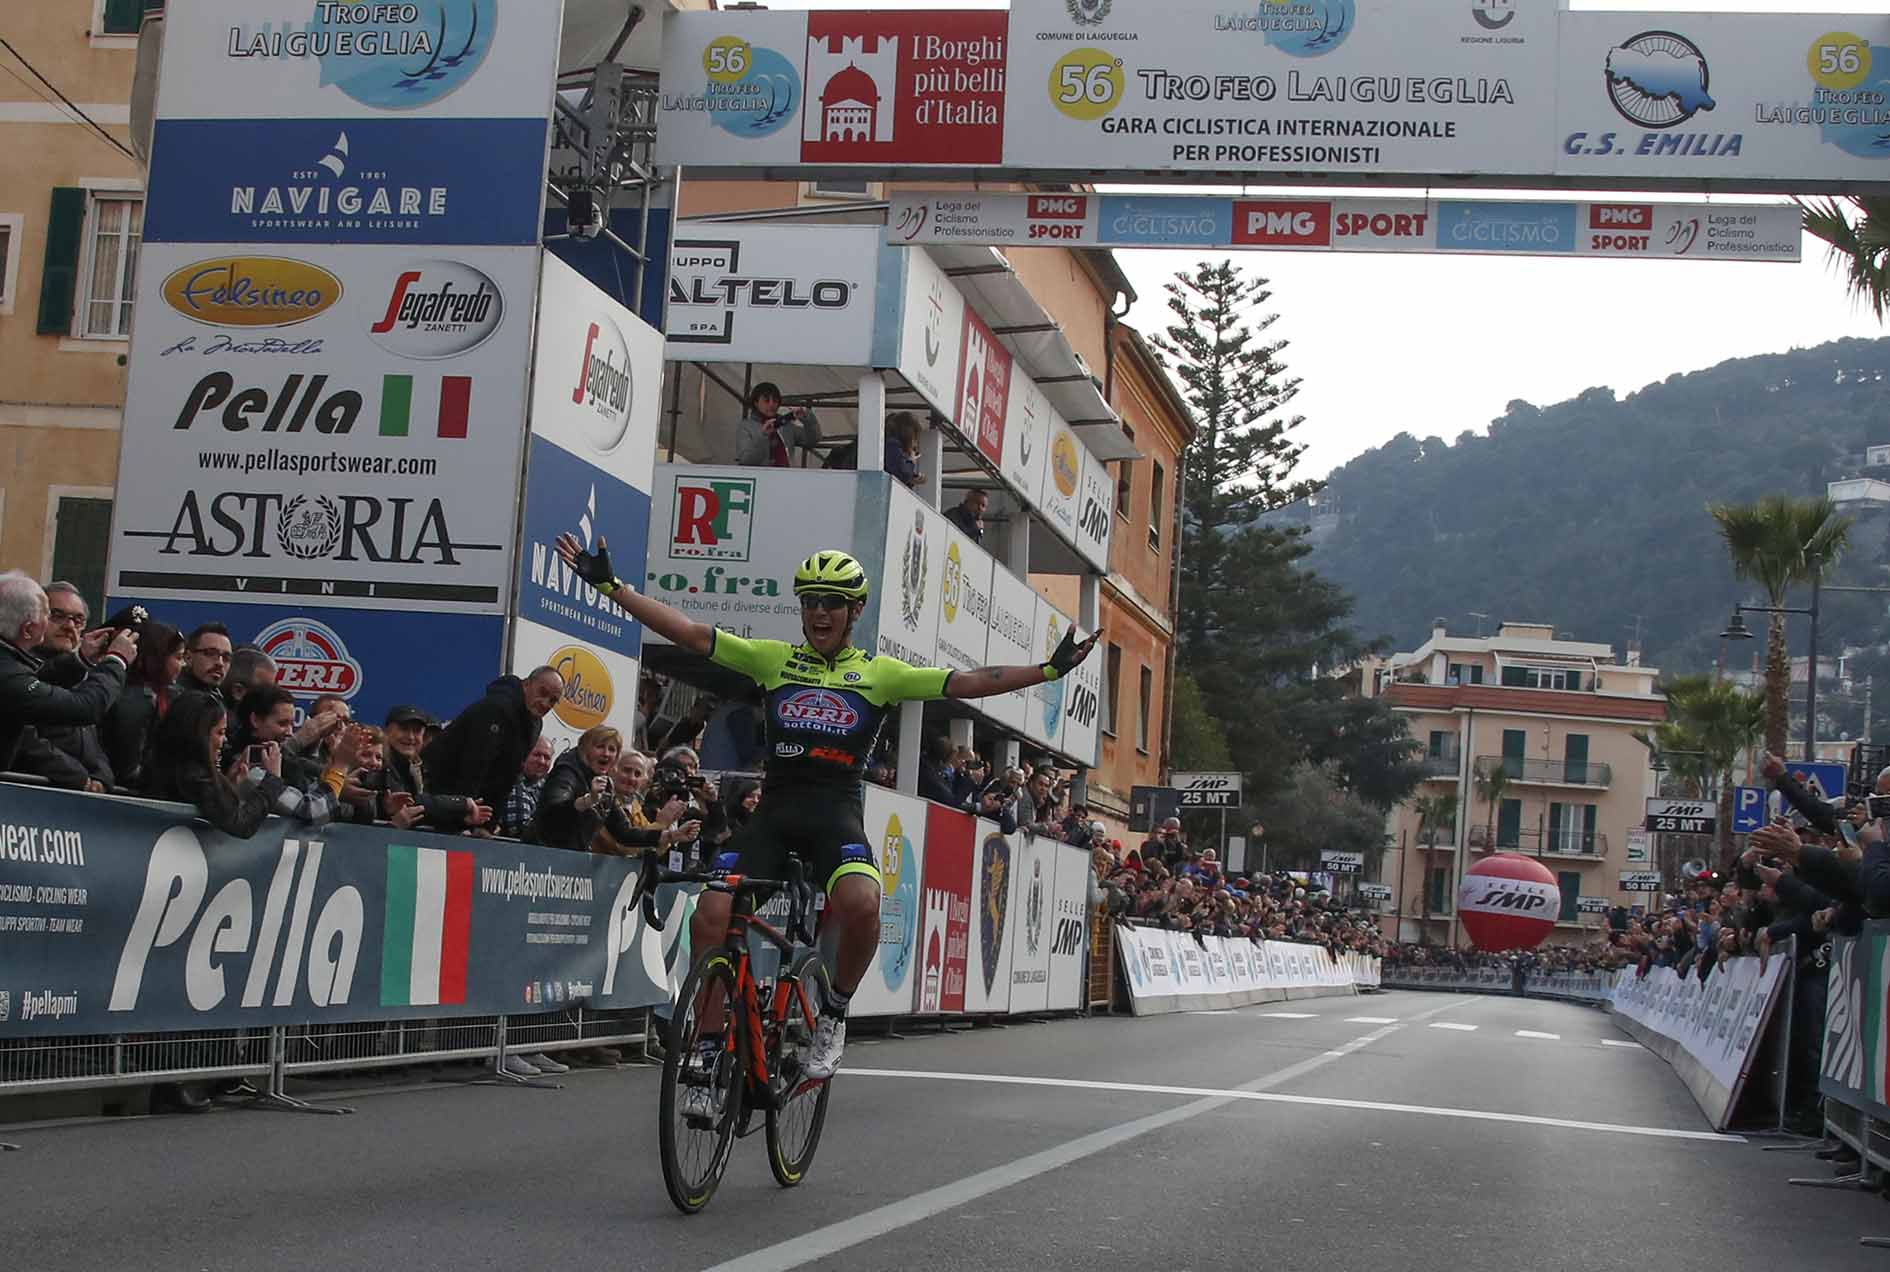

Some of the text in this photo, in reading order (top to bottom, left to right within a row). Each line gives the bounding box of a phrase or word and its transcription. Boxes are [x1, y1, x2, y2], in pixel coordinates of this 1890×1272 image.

[318, 1, 419, 24] TROFEO
[228, 27, 432, 57] LAIGUEGLIA
[1036, 31, 1138, 42] COMUNE DI LAIGUEGLIA
[912, 35, 1003, 65] I Borghi
[913, 67, 1004, 97] più belli
[1137, 68, 1514, 105] TROFEO LAIGUEGLIA
[1101, 116, 1456, 139] GARA CICLISTICA INTERNAZIONALE
[1173, 143, 1380, 164] PER PROFESSIONISTI
[1563, 132, 1743, 157] G.S. EMILIA
[231, 186, 448, 216] NAVIGARE
[935, 201, 961, 214] Lega
[1037, 200, 1077, 214] PMG
[252, 219, 421, 230] SPORTSWEAR AND LEISURE
[935, 213, 979, 225] Ciclismo
[1248, 211, 1316, 235] PMG
[1336, 213, 1428, 238] SPORT
[1599, 207, 1643, 224] PMG
[934, 226, 1015, 238] Professionistico
[1028, 225, 1083, 240] SPORT
[1592, 234, 1649, 250] SPORT
[1708, 227, 1754, 239] Ciclismo
[1708, 240, 1795, 253] Professionistico
[371, 271, 493, 334] Segafredo
[424, 324, 468, 334] ZANETTI
[173, 371, 364, 434] Pella
[199, 449, 437, 477] www.pellasportswear.com
[235, 578, 376, 596] VINI
[682, 599, 718, 610] tribune
[721, 600, 731, 610] di
[734, 601, 770, 614] diverse
[783, 703, 852, 724] NERI
[1067, 684, 1097, 729] SMP
[1184, 780, 1229, 789] SMP
[1182, 792, 1231, 804] 25 MT
[1741, 788, 1759, 812] P
[1659, 805, 1704, 816] SMP
[1656, 817, 1705, 832] 25 MT
[0, 824, 84, 866] ear.com
[37, 886, 66, 905] CYCLING
[67, 888, 88, 906] WEAR
[1641, 883, 1656, 891] MT
[1475, 891, 1546, 910] SMP
[66, 918, 84, 933] WEAR
[108, 825, 365, 1011] Pella
[1052, 918, 1082, 955] SMP
[22, 990, 78, 1021] #pellapmi
